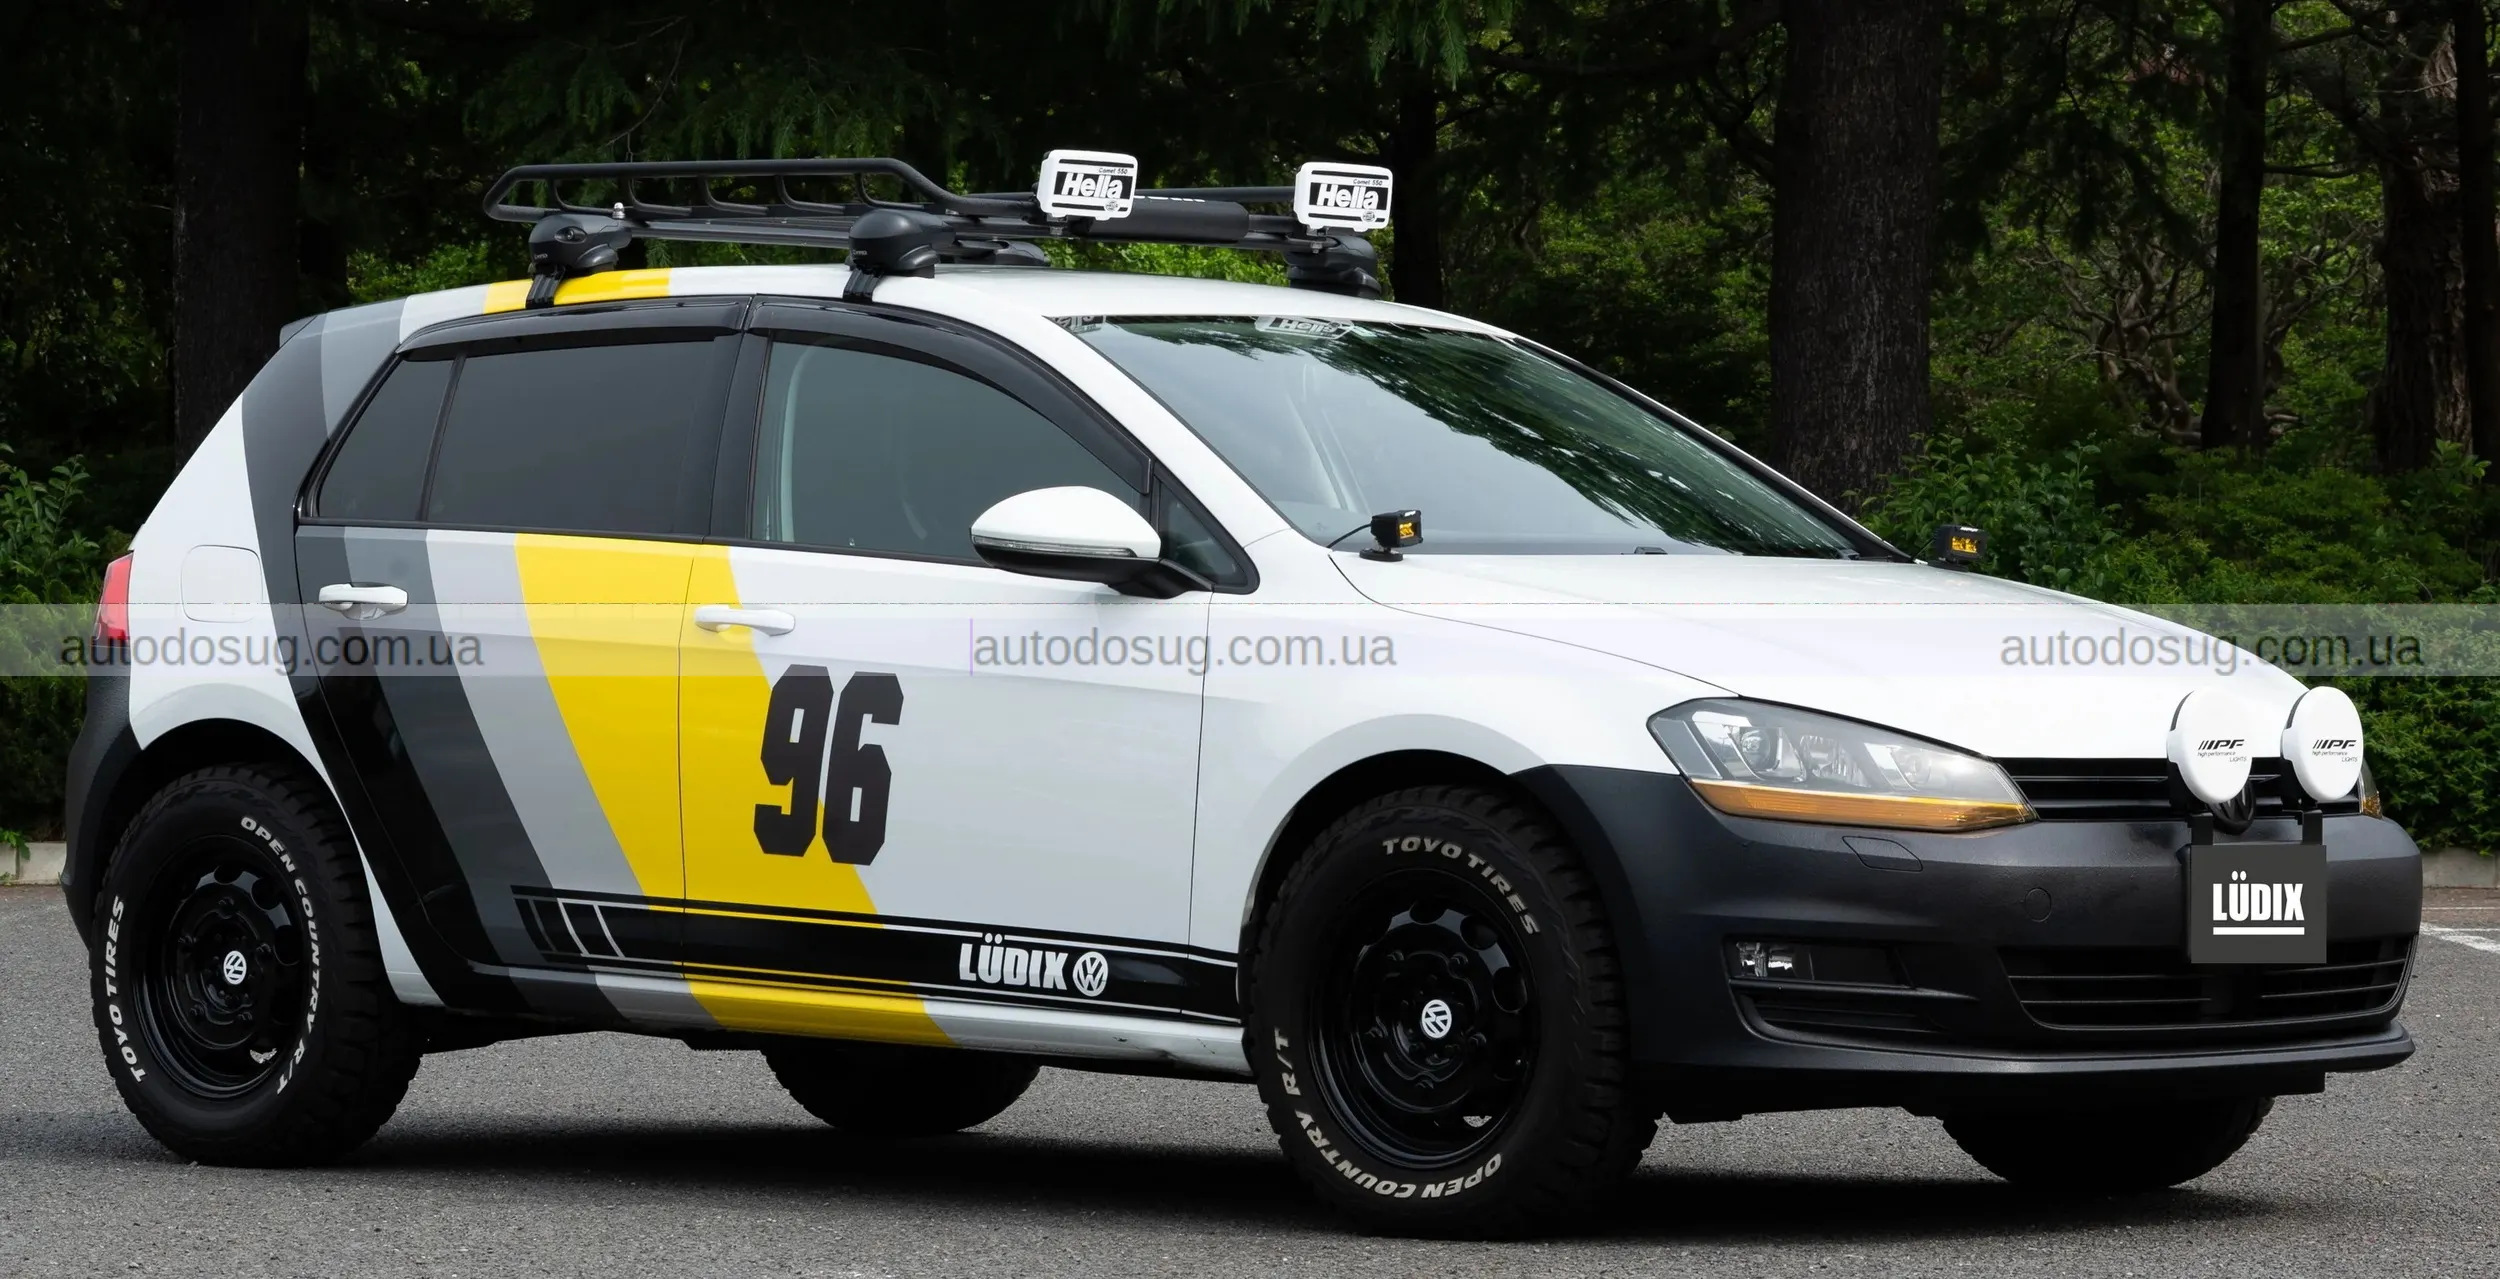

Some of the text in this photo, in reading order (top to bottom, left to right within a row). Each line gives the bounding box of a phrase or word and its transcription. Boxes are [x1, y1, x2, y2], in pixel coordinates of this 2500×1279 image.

[1061, 172, 1123, 199] Hella
[1317, 183, 1379, 210] Hella
[753, 664, 904, 866] 96
[1383, 837, 1541, 936] TOYO TIRES
[2212, 870, 2305, 922] LÜDIX
[104, 895, 147, 1083] TOYO TIRES
[240, 816, 321, 1096] OPEN COUNTRY R/T
[959, 932, 1069, 990] LÜDIX
[1274, 1026, 1503, 1199] OPEN COUNTRY R/T
